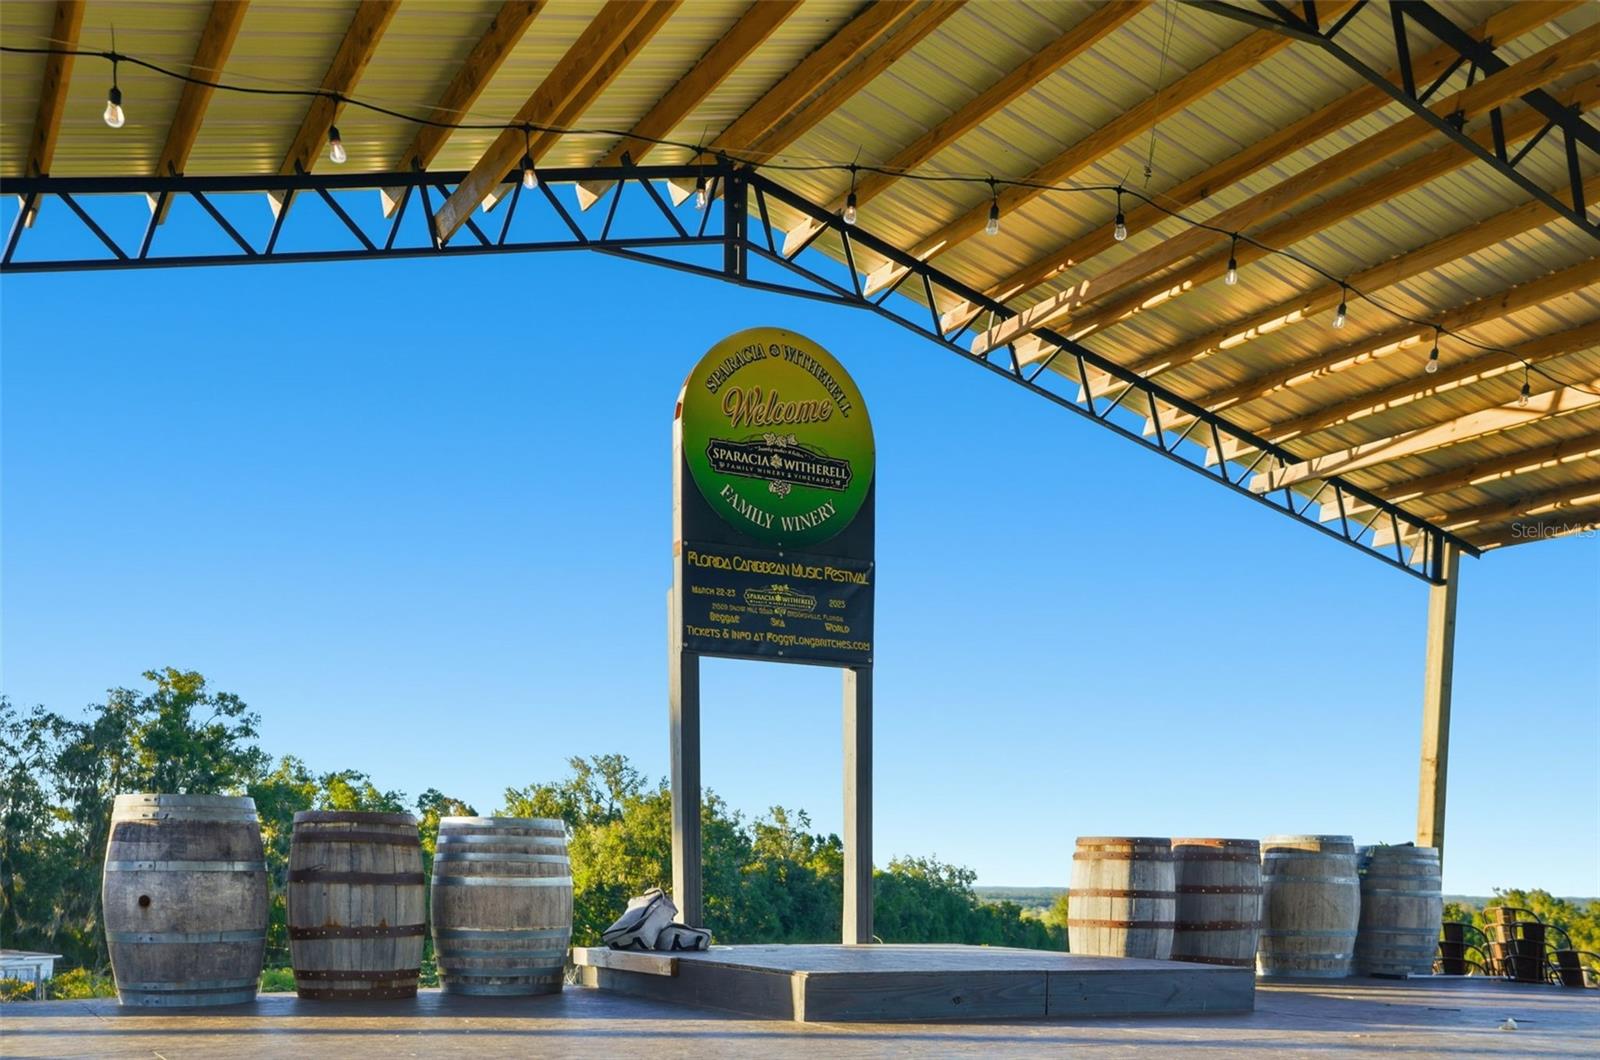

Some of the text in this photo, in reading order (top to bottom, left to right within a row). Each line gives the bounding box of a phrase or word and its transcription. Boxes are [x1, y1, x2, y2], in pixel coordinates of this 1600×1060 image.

[705, 343, 852, 418] SPARACIA WITHERELL
[722, 385, 833, 428] Welcome
[712, 447, 770, 467] SPARACIA
[784, 459, 848, 480] WITHERELL
[726, 463, 753, 472] FAMILY
[757, 468, 785, 478] WINERY
[794, 474, 835, 485] VINEYARDS
[720, 484, 836, 532] FAMILY WINERY
[688, 551, 732, 570] FLORIDA
[792, 562, 823, 581] MUSIC
[824, 566, 870, 585] FESTIVAL
[691, 585, 736, 598] MARCH 22-23
[686, 625, 721, 639] TICKETS
[731, 629, 752, 641] INFO
[753, 632, 765, 642] AT
[824, 622, 850, 634] WORLD
